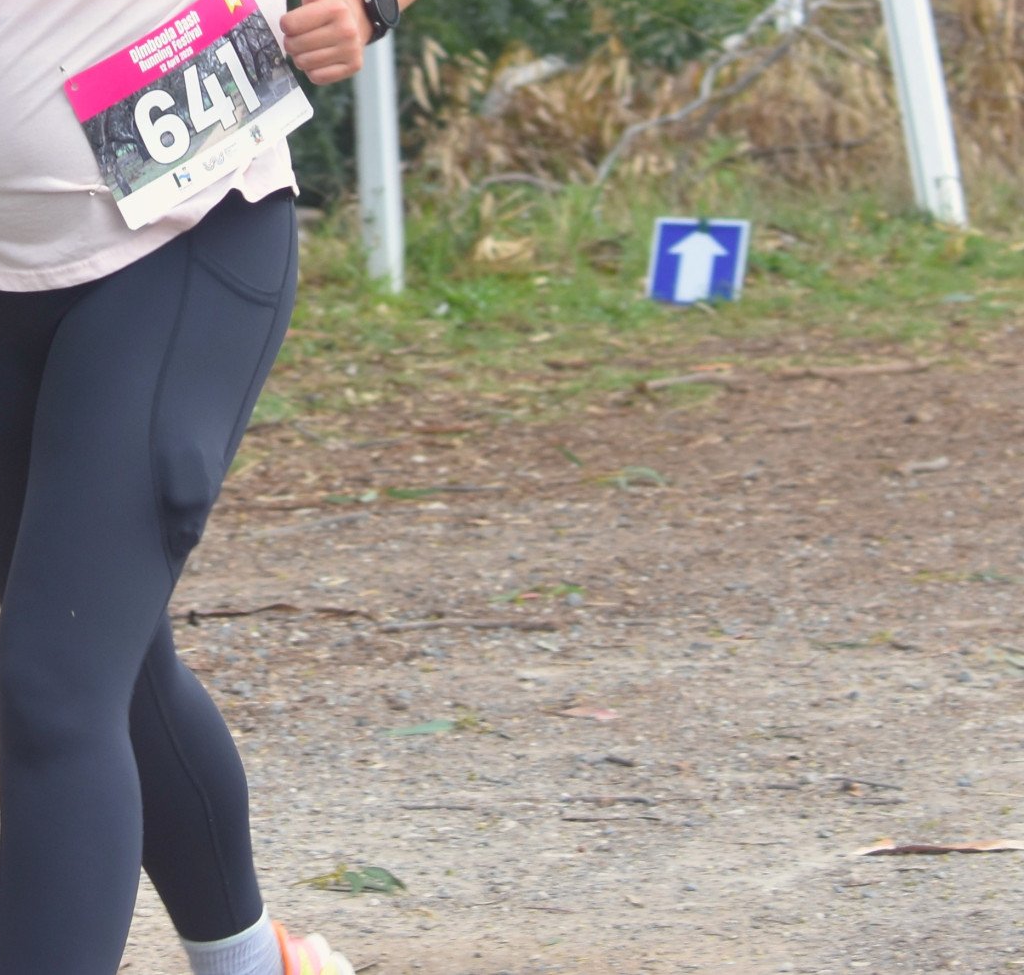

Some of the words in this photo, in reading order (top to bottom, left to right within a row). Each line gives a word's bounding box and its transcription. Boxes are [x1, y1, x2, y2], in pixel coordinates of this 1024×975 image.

[129, 27, 176, 63] Dimboola
[175, 11, 200, 34] Dash
[139, 45, 173, 72] Running
[173, 24, 203, 51] Festival
[134, 40, 261, 164] 641
